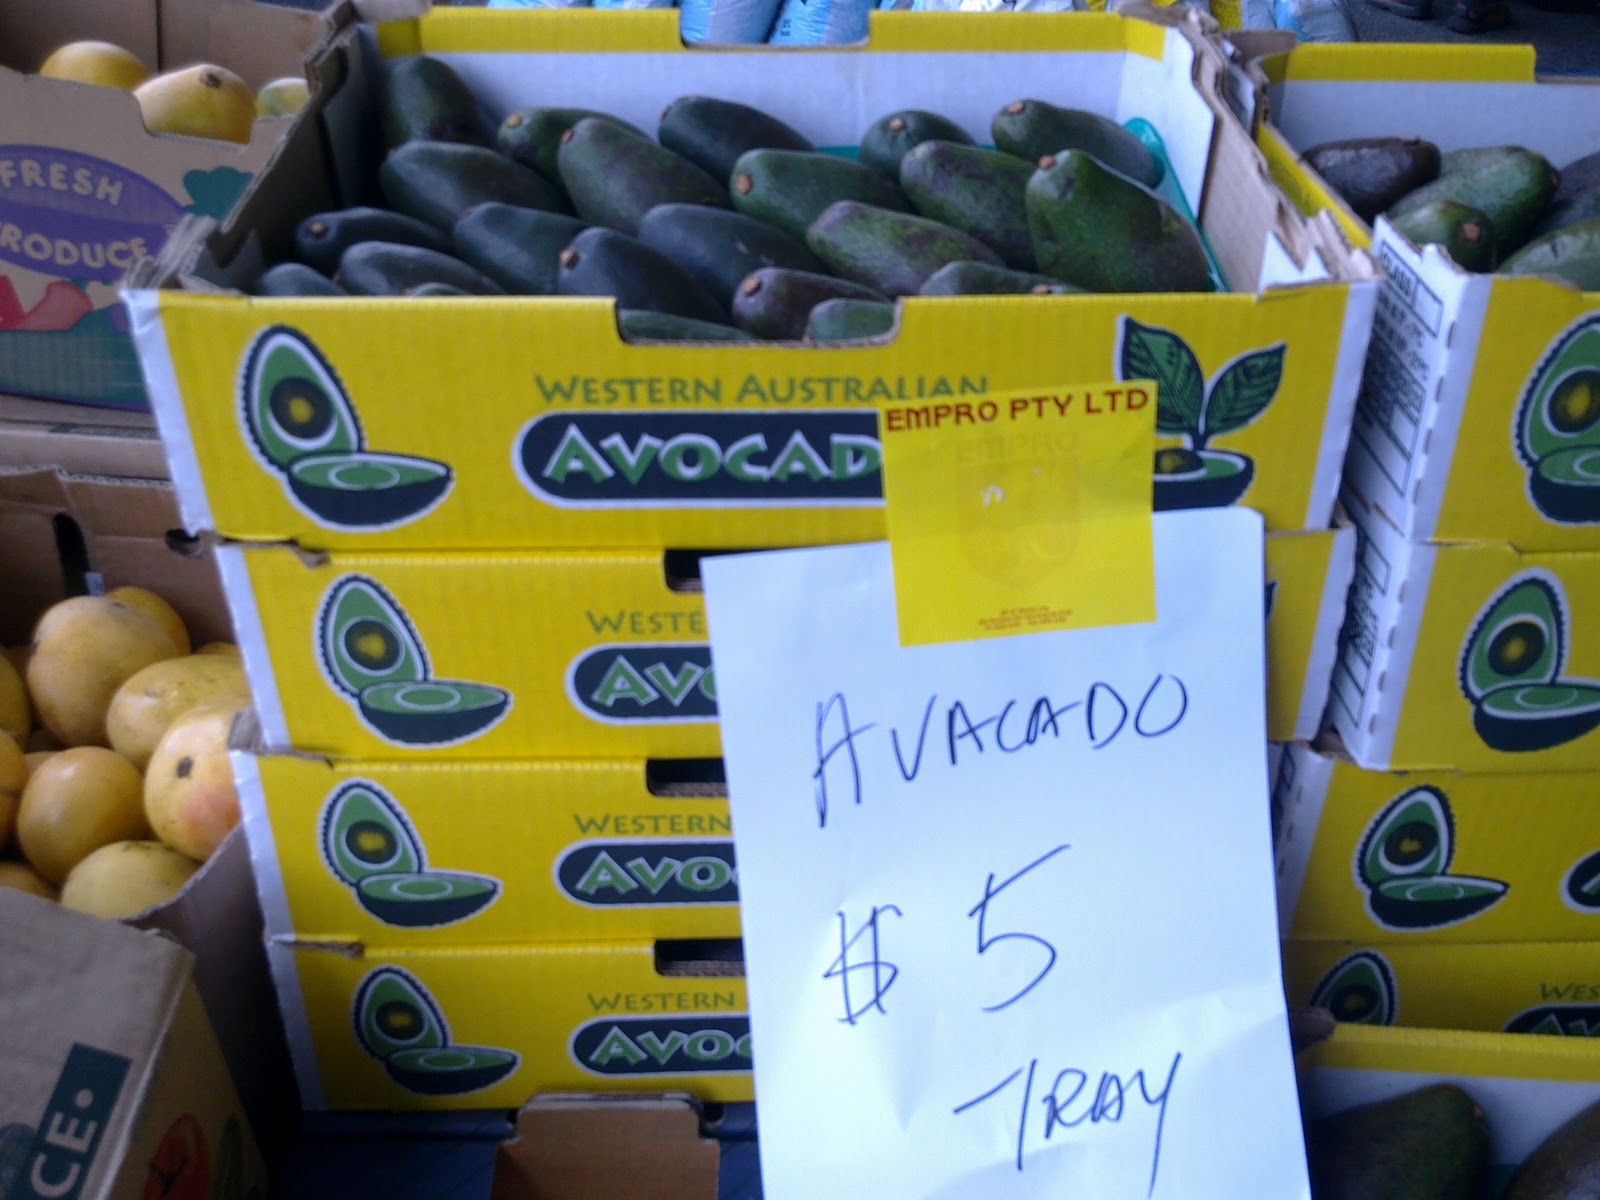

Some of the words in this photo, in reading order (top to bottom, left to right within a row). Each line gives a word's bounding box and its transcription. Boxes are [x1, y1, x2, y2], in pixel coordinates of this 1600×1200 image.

[0, 159, 123, 206] FRESH
[534, 375, 723, 404] WESTERN
[736, 375, 989, 404] AUSTRALIAN
[887, 401, 999, 432] EMPRO
[1009, 394, 1073, 420] PTY
[1085, 388, 1149, 414] LTD
[813, 672, 1189, 829] AVACADO
[573, 812, 733, 835] WESTERN
[575, 850, 740, 895] AVO
[587, 991, 736, 1011] WESTERN
[952, 1051, 1182, 1199] TRAY
